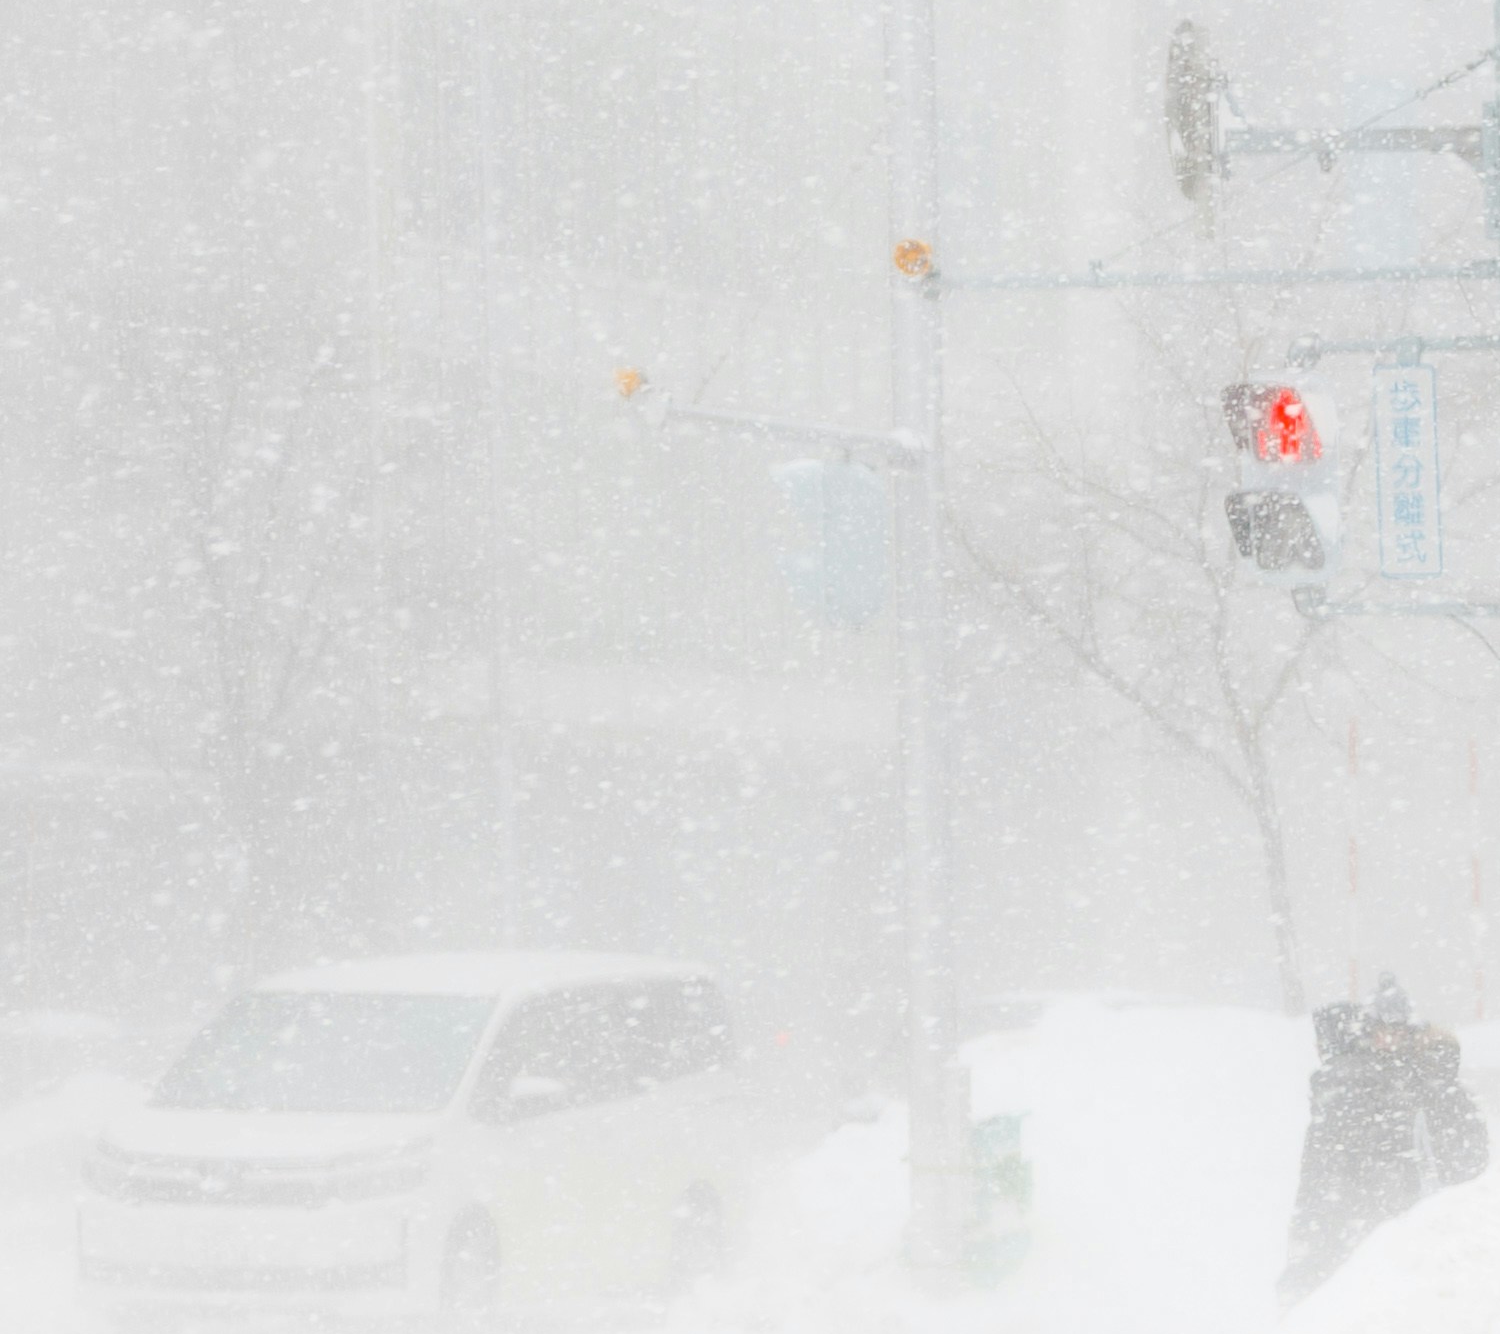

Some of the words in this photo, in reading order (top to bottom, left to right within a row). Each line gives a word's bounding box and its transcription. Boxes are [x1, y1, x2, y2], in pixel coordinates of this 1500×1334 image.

[1388, 380, 1427, 564] 歩車分離式
